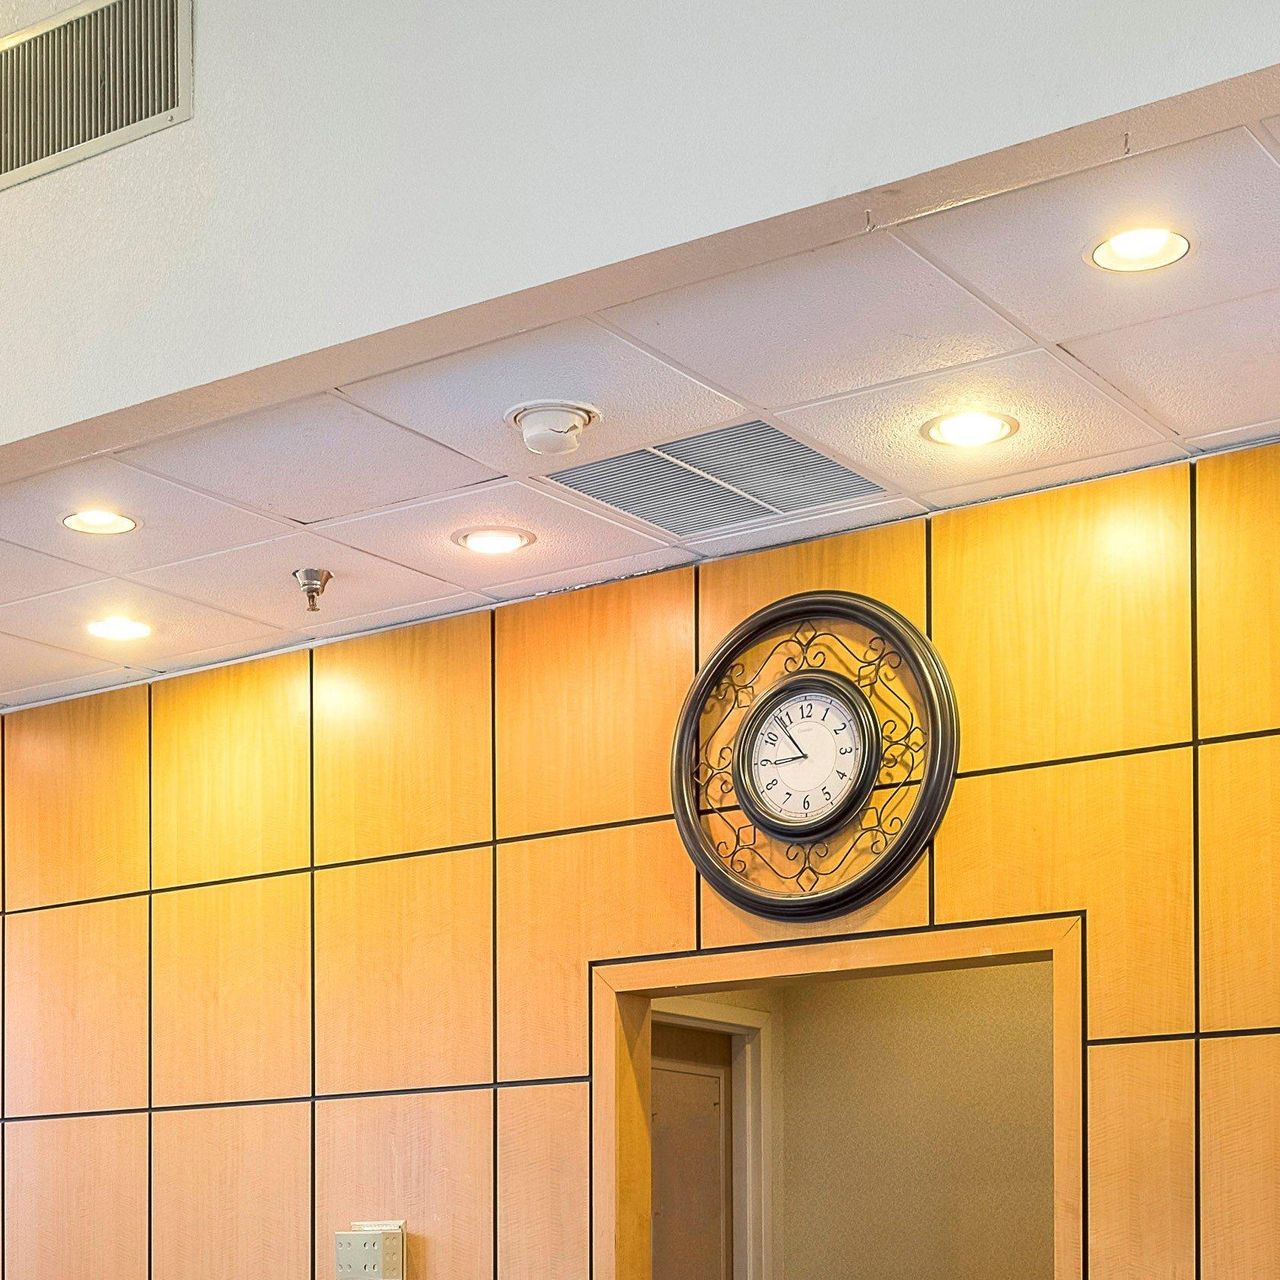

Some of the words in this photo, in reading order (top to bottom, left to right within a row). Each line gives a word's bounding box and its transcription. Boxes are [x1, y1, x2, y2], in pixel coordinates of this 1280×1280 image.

[799, 703, 813, 719] 12
[821, 707, 830, 721] 1
[780, 711, 794, 728] 11
[833, 722, 847, 735] 2
[764, 731, 779, 747] 10
[839, 747, 853, 755] 3
[760, 758, 773, 767] 9
[835, 769, 847, 780] 4
[765, 778, 778, 791] 8
[782, 792, 792, 805] 7
[821, 786, 831, 801] 5
[802, 795, 810, 810] 6
